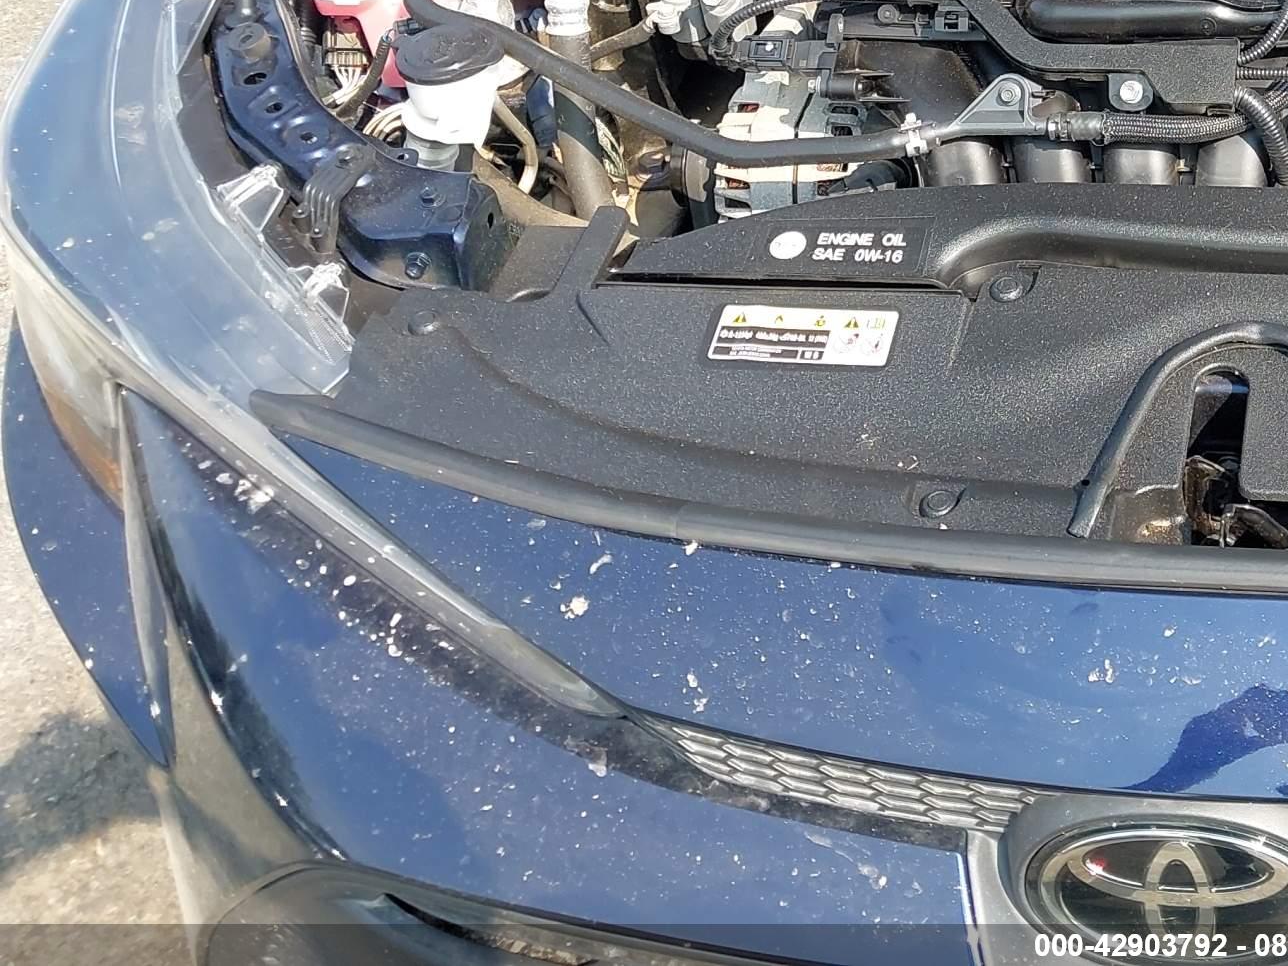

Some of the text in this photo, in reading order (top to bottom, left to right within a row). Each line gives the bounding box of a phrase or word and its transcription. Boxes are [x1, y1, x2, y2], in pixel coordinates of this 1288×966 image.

[817, 233, 906, 246] ENGINE OIL
[812, 248, 903, 264] SAE 0W-16
